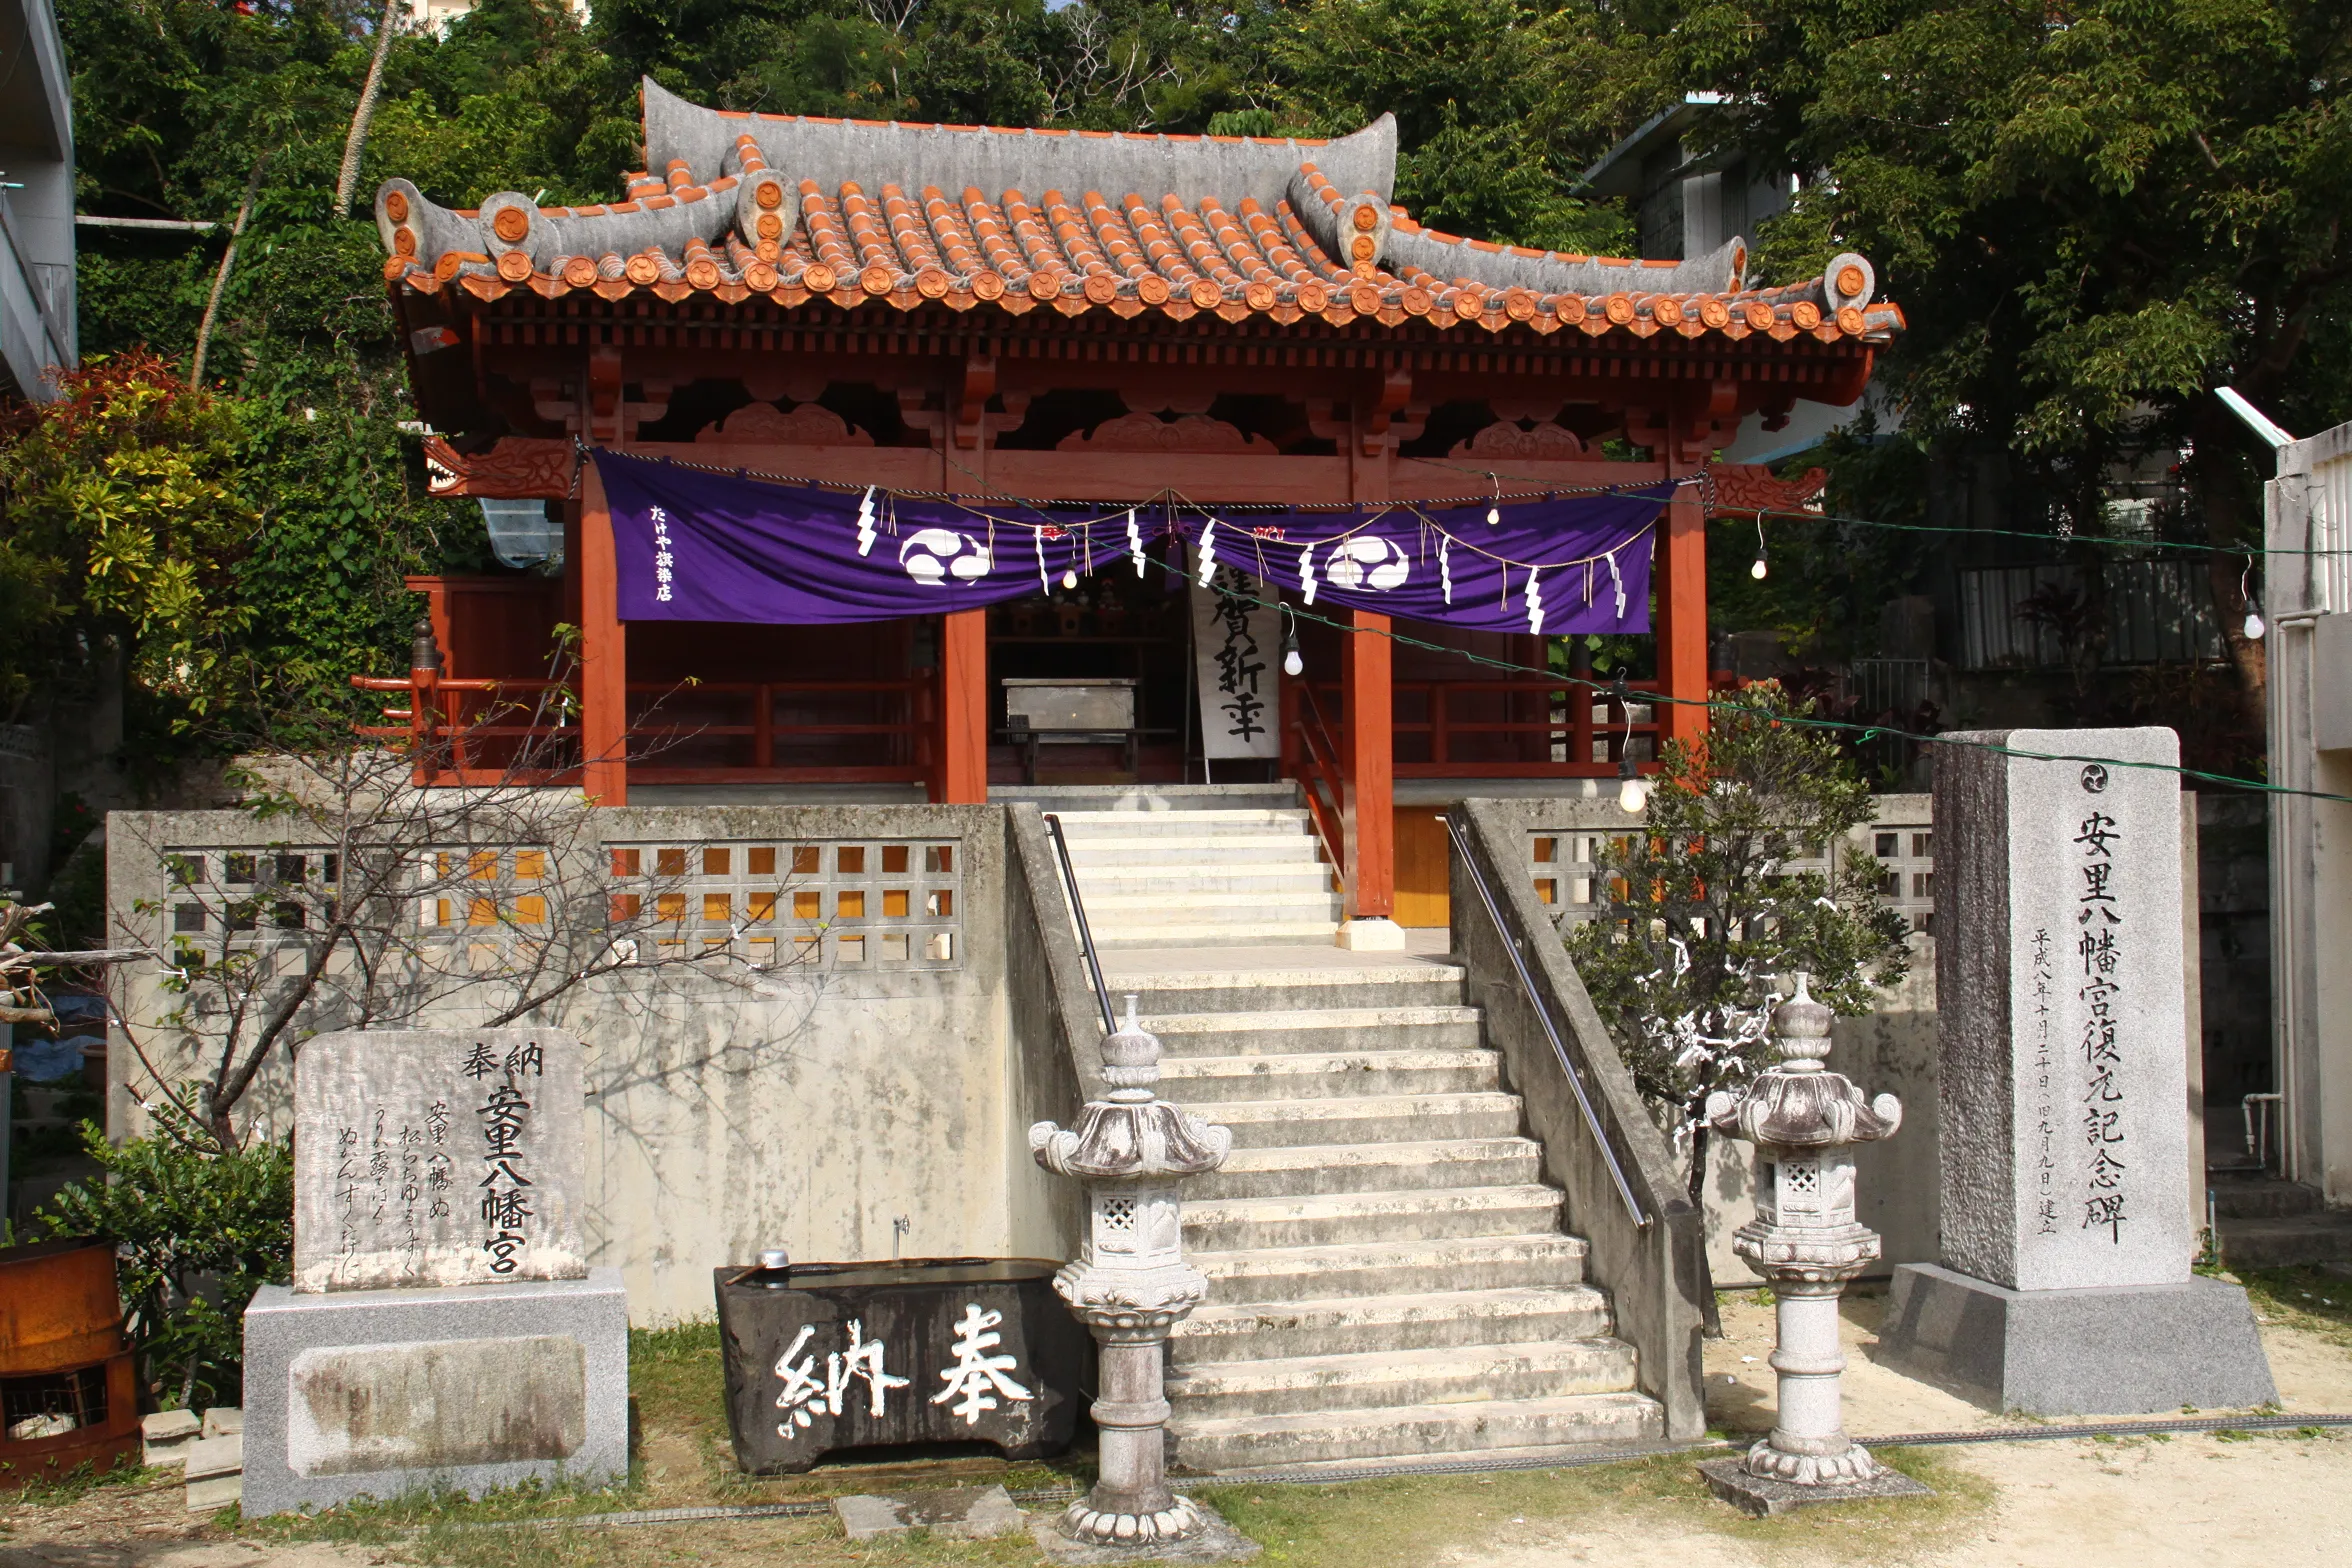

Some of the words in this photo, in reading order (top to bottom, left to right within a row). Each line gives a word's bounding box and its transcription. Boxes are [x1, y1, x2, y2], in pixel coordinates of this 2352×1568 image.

[650, 505, 674, 601] たけや旗染店
[461, 1041, 544, 1081] 奉納
[2073, 811, 2127, 1245] 安里八幡宮復元記念碑
[475, 1086, 534, 1274] 安里八幡宮
